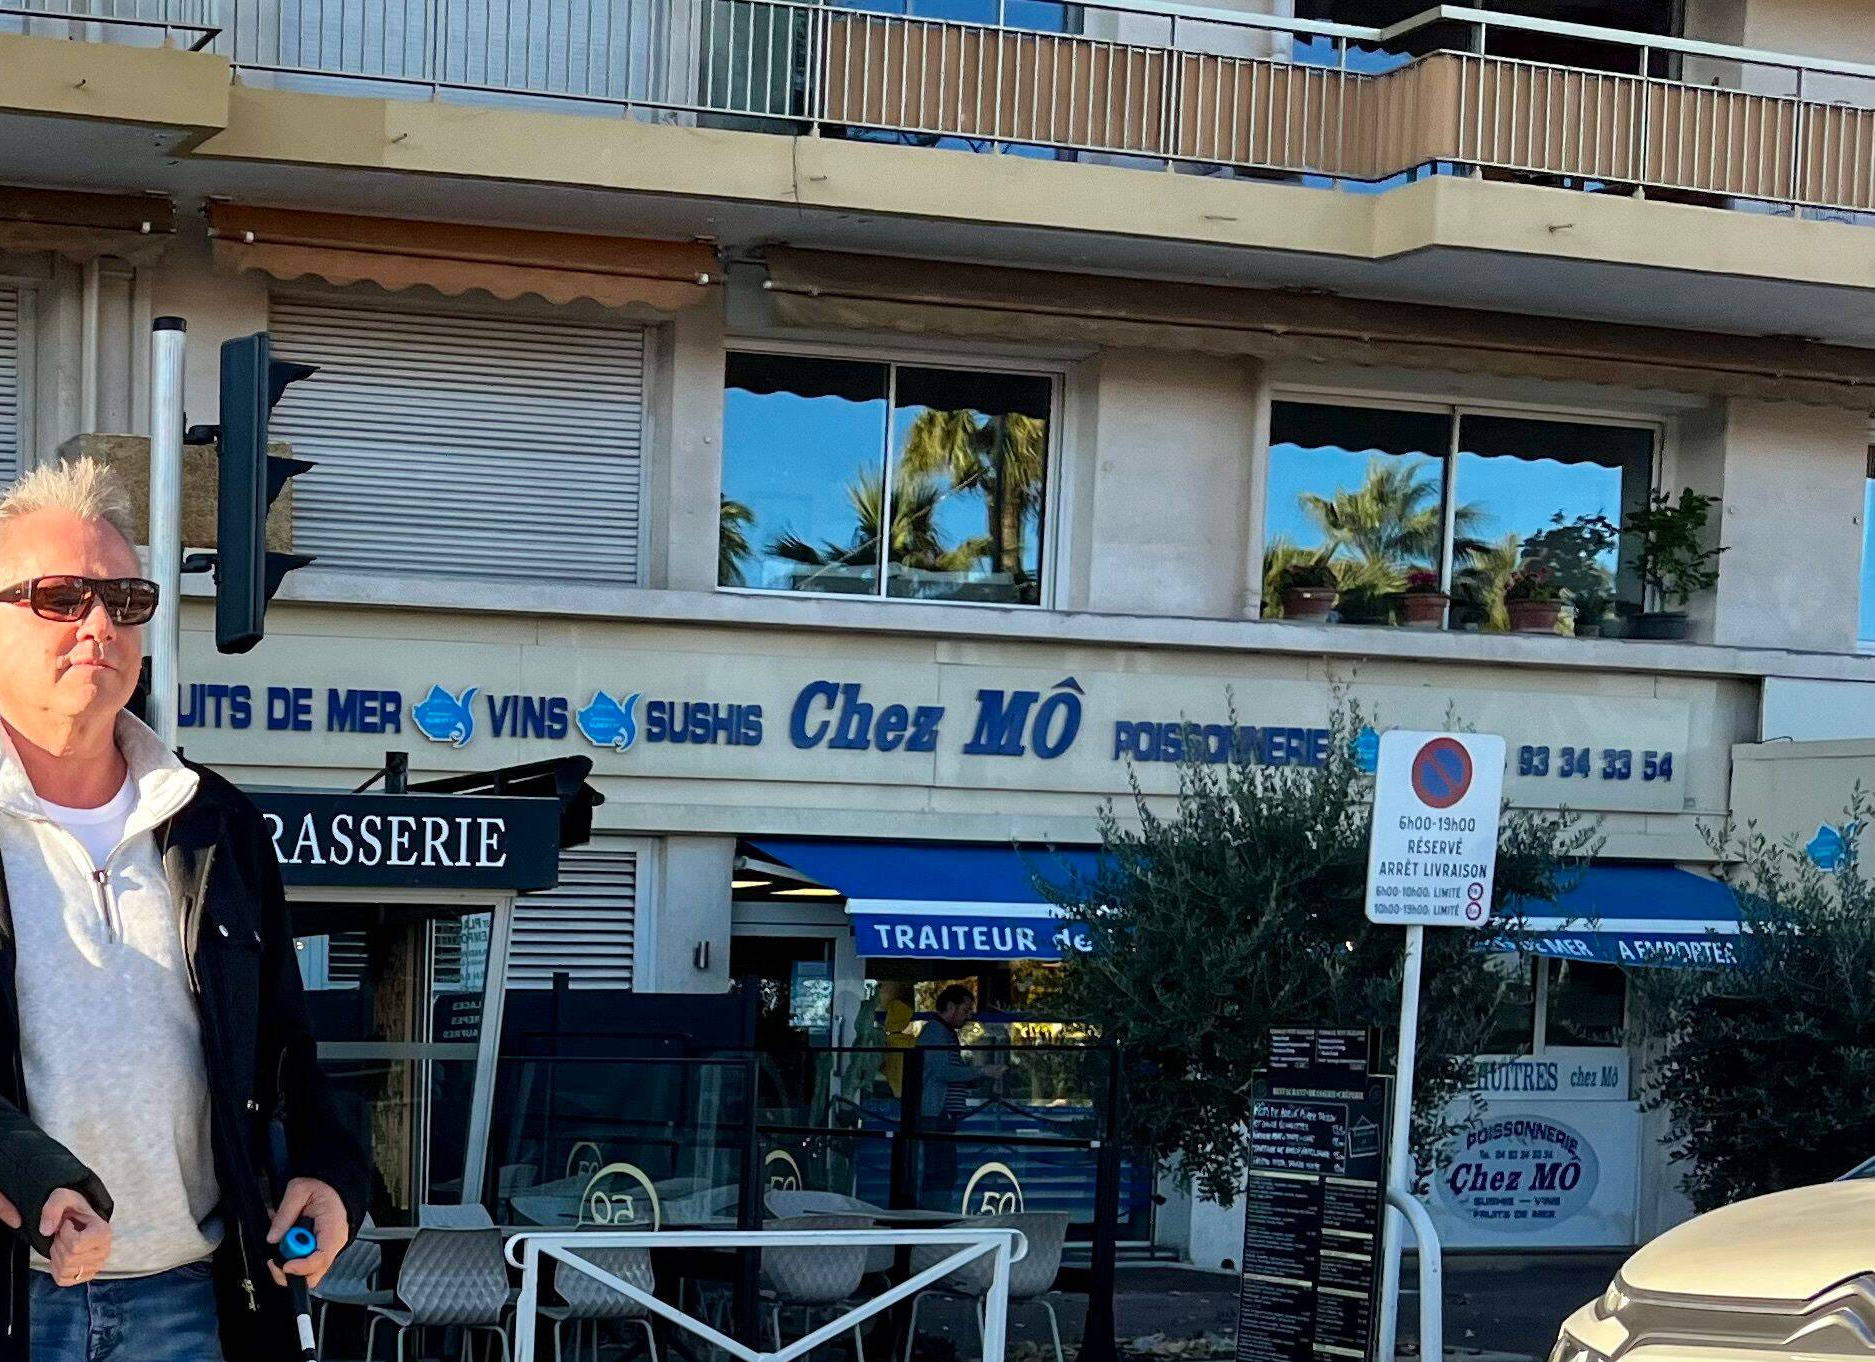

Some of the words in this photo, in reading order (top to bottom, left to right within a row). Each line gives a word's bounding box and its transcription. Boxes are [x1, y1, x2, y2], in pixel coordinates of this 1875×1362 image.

[177, 683, 251, 729] UITS
[267, 687, 312, 731] DE
[328, 688, 402, 733] MER
[486, 695, 568, 739] VINS
[645, 700, 763, 746] SUSHIS
[789, 679, 945, 750] Chez
[963, 676, 1085, 759] MÔ
[1558, 747, 1592, 778] 34
[1398, 816, 1476, 832] 6h00-19h00
[262, 813, 507, 867] RASSERIE
[1407, 836, 1463, 855] RÉSERVÉ
[1379, 859, 1419, 877] ARRÊT
[1424, 863, 1488, 878] LIVRAISON
[1433, 887, 1461, 899] LIMITÉ
[1433, 904, 1459, 917] LIMITÉ
[873, 924, 1037, 951] TRAITEUR
[1540, 937, 1594, 958] MER
[1570, 1066, 1597, 1087] chez
[1467, 1121, 1580, 1155] POISSONNERIE
[1448, 1163, 1523, 1194] Chez
[1527, 1156, 1582, 1191] MÔ
